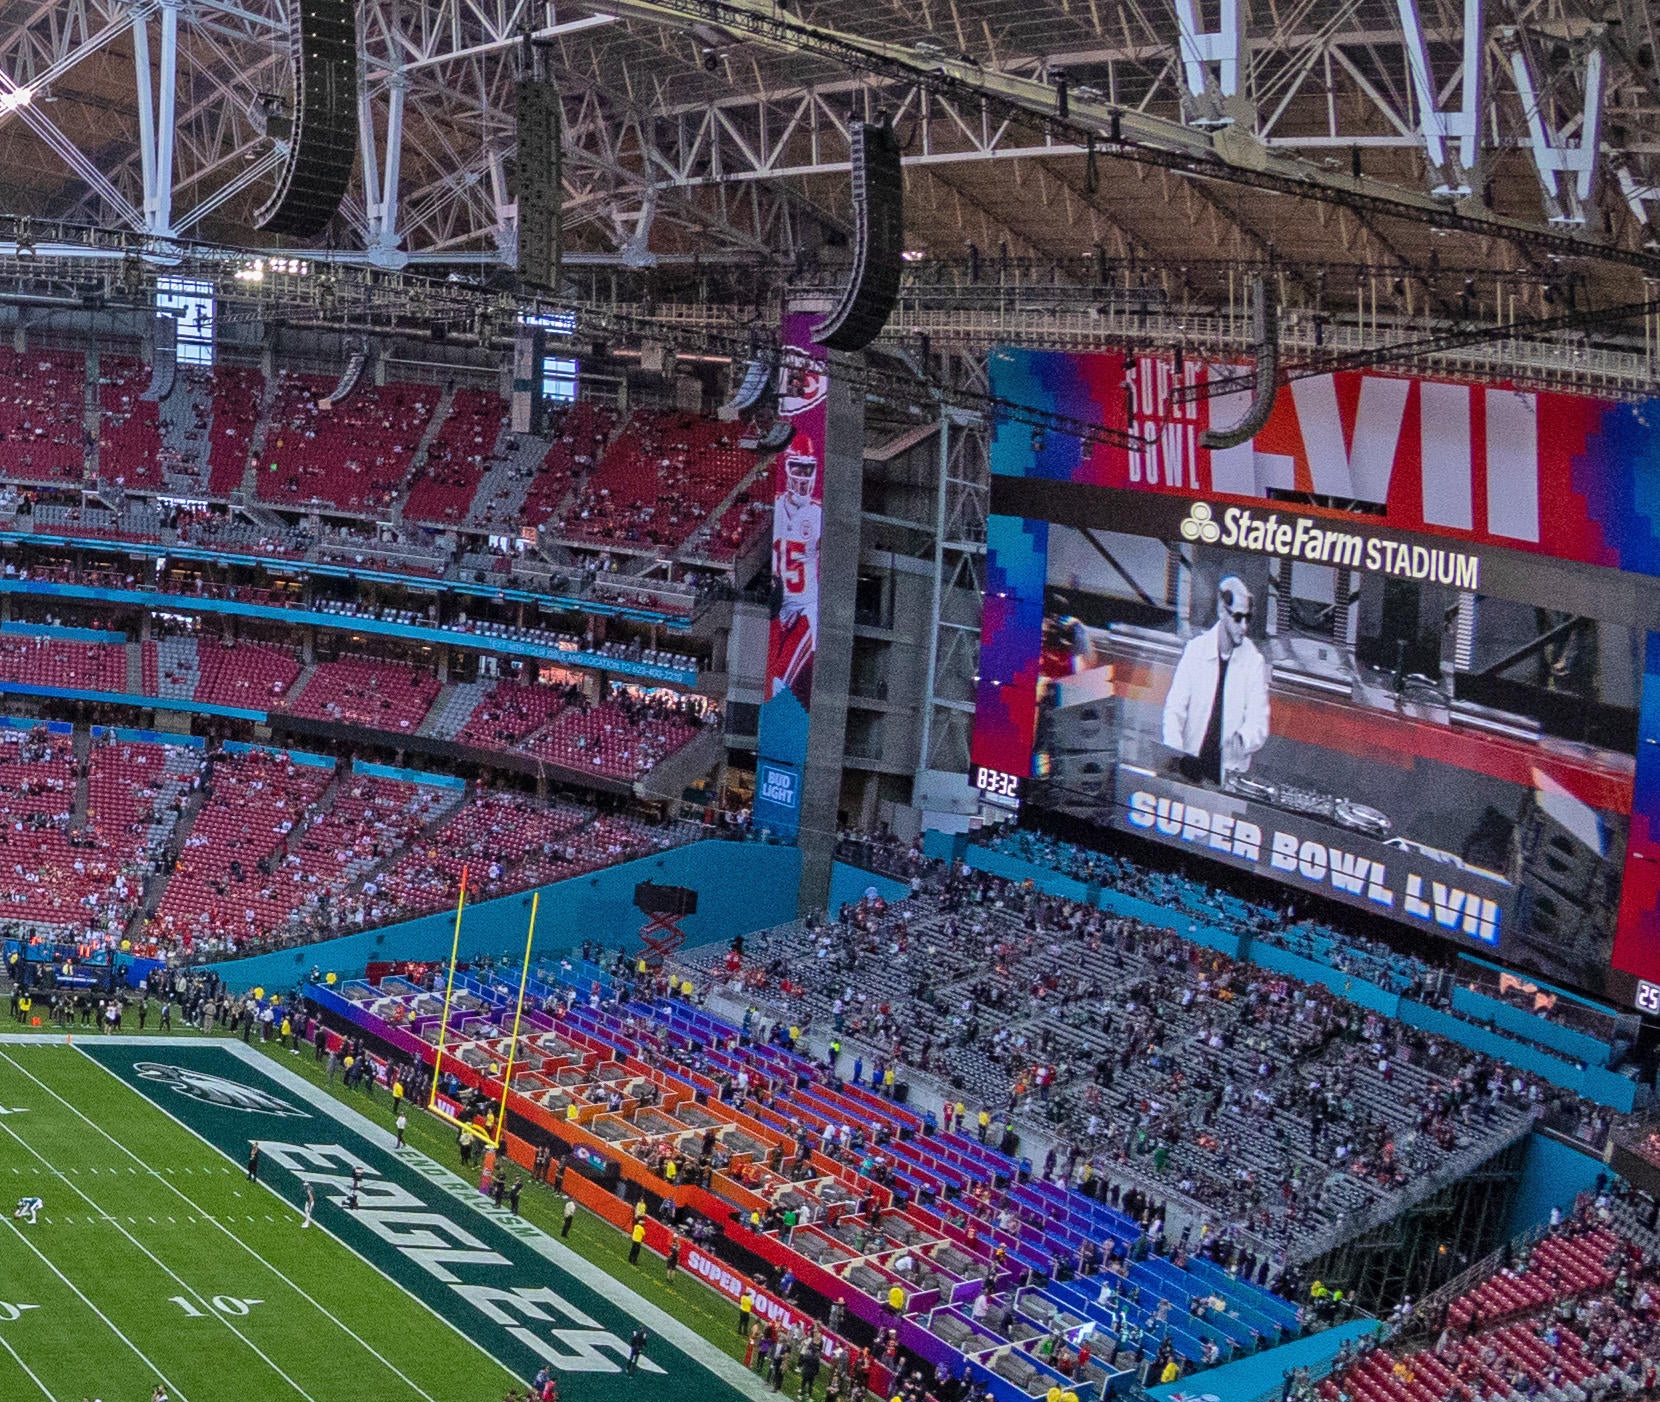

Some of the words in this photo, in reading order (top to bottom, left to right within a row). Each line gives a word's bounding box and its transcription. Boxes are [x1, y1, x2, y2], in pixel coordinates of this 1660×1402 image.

[1208, 363, 1539, 543] LVII
[1366, 539, 1479, 590] STADIUM
[762, 783, 794, 803] LIGHT
[767, 771, 791, 789] BUD
[976, 767, 1018, 796] 83:32
[1127, 791, 1262, 862] SUPER
[1270, 830, 1393, 908] BOWL
[1404, 873, 1502, 948] LVII
[1639, 984, 1659, 1010] 25
[396, 1150, 449, 1178] END
[440, 1175, 544, 1239] RACISM
[248, 1139, 669, 1375] EAGLES
[688, 1251, 742, 1297] SUPER
[168, 1295, 250, 1318] 10
